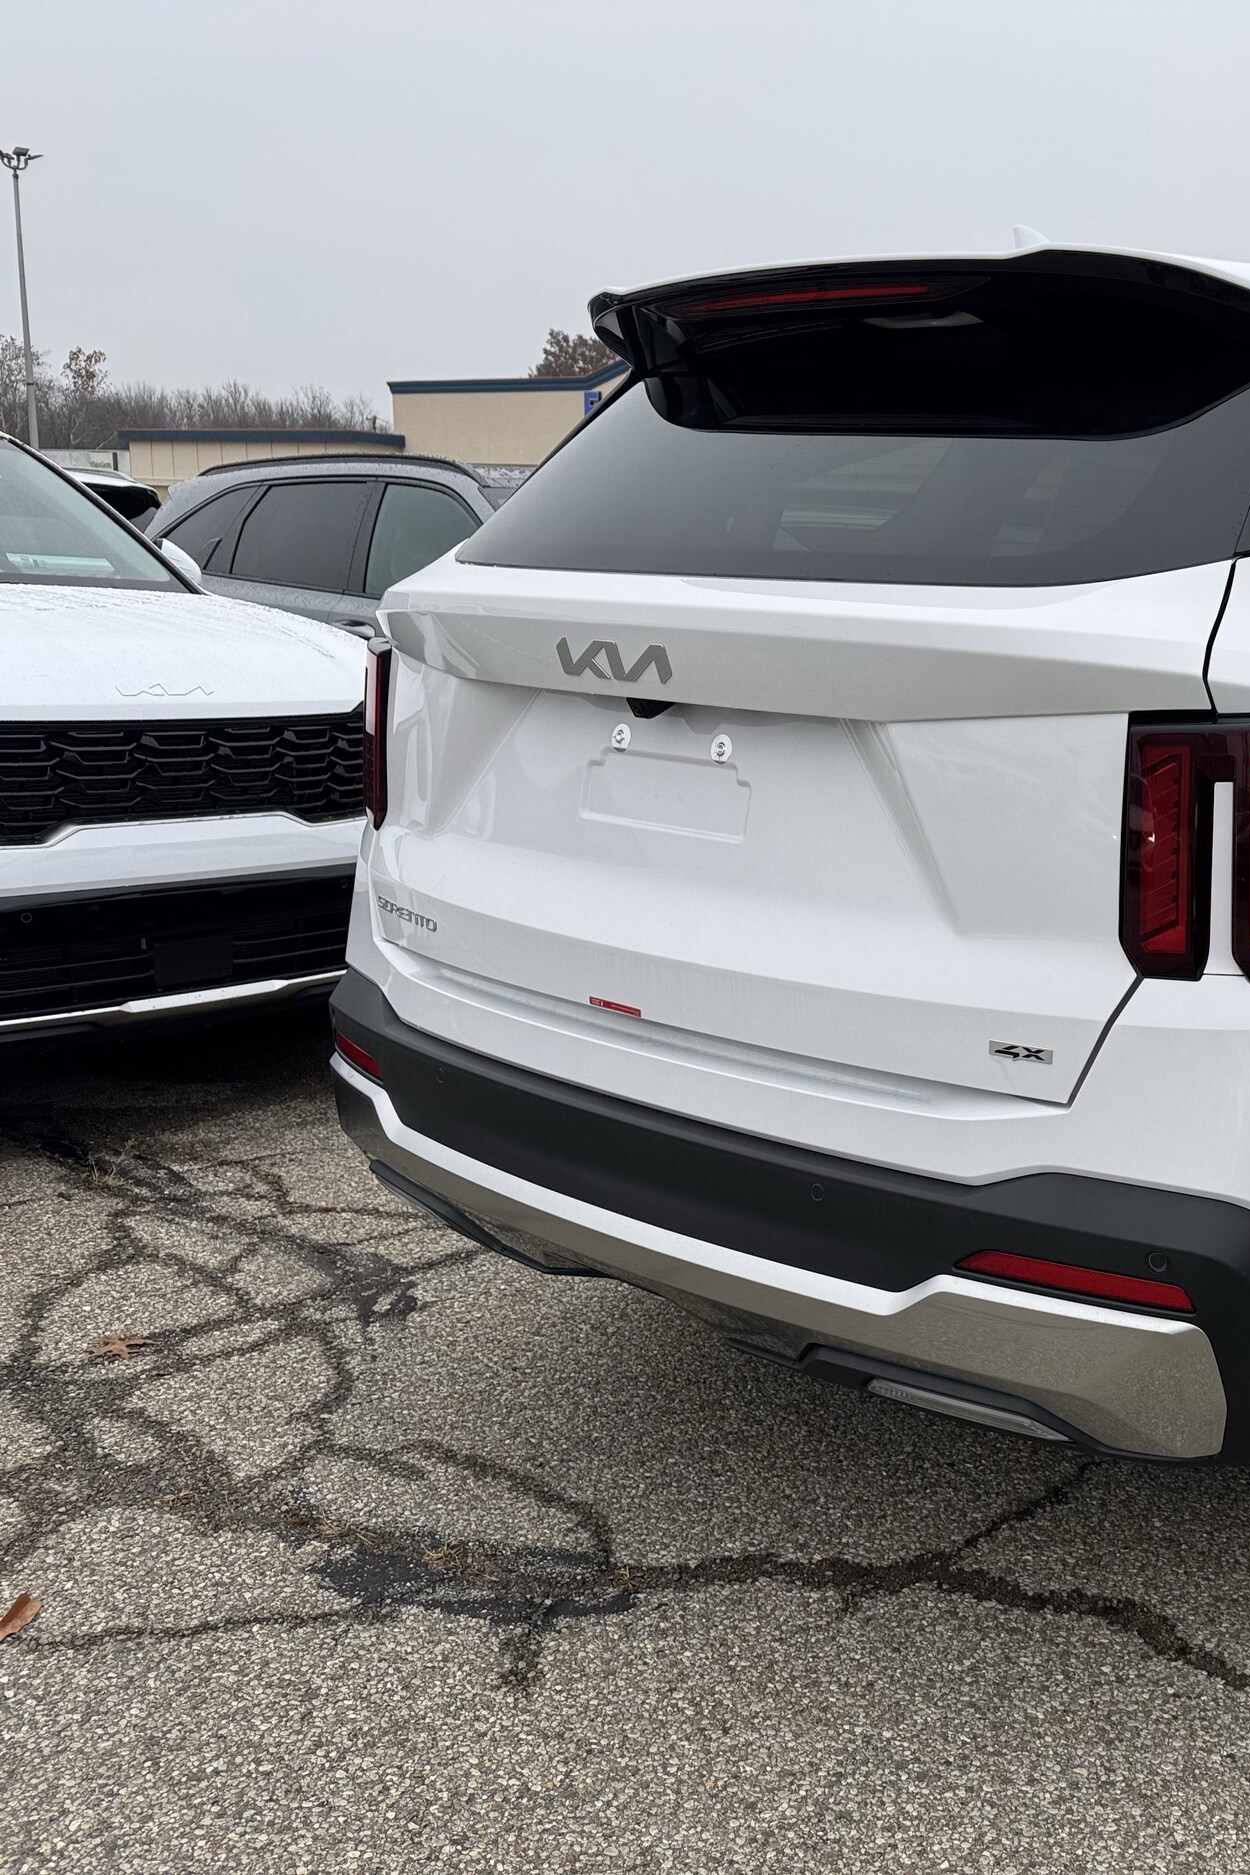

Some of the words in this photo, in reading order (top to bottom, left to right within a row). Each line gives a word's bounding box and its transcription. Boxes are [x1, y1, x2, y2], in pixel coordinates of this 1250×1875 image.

[555, 636, 673, 685] KIA
[377, 895, 438, 932] SORENTO
[994, 1045, 1046, 1062] 4X
